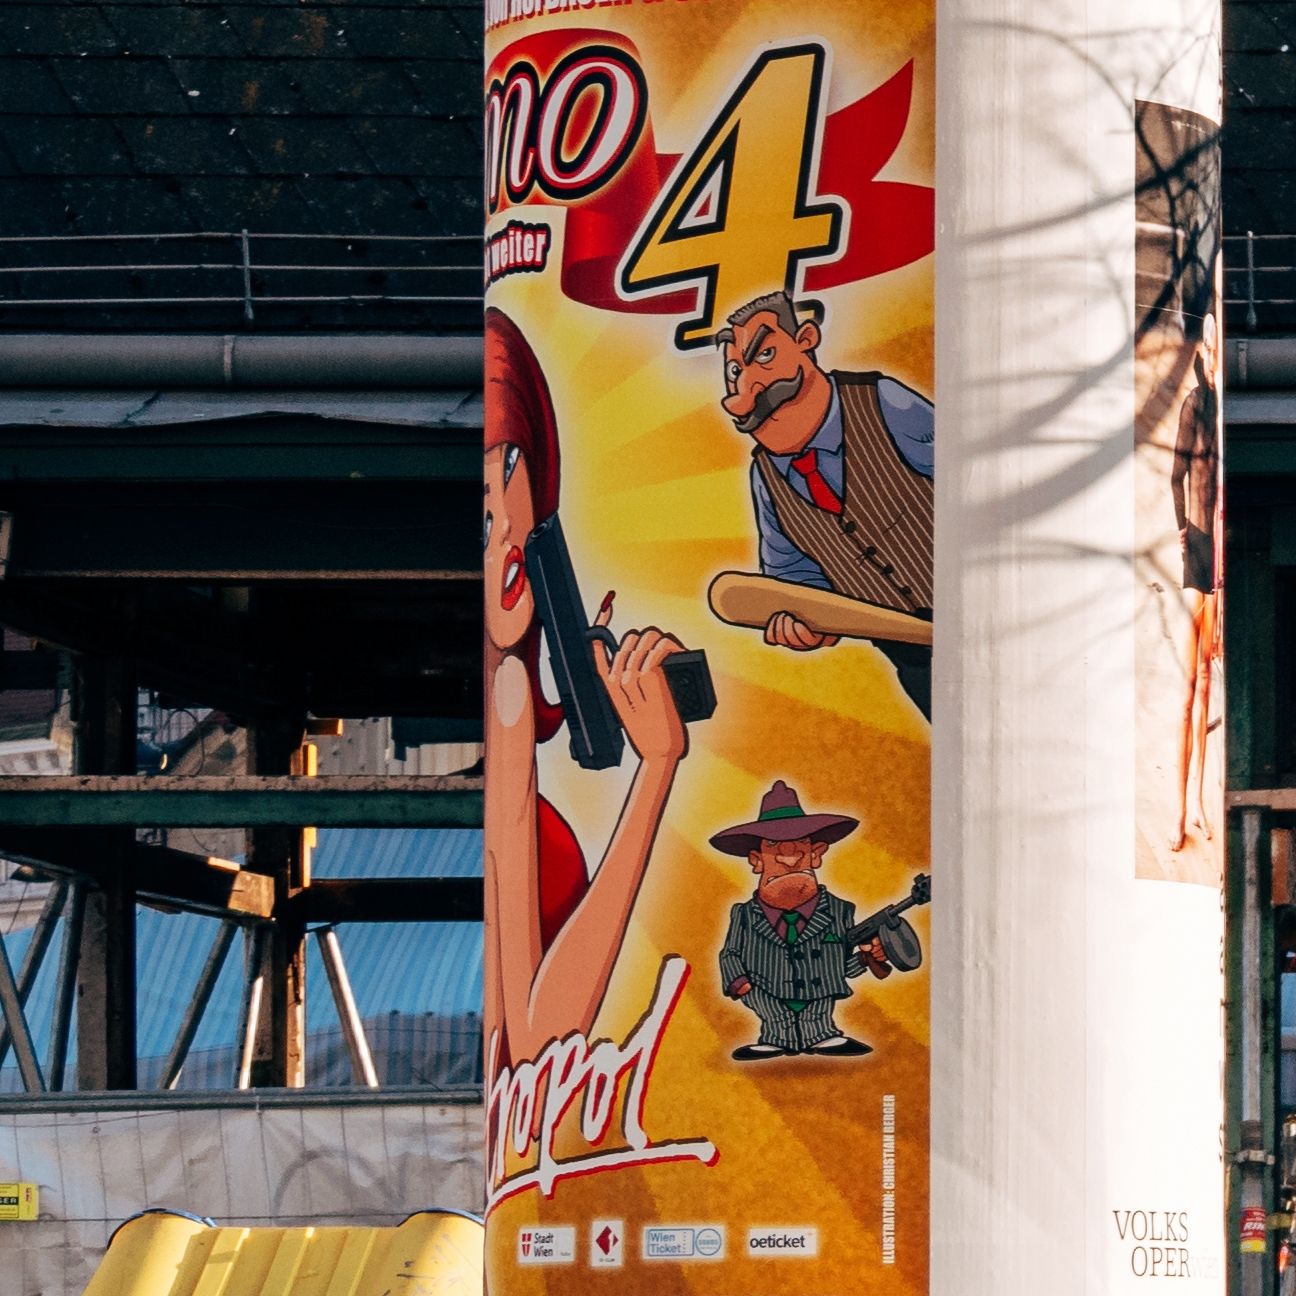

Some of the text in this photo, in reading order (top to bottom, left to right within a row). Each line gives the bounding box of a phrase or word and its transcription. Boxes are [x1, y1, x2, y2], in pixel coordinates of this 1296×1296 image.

[620, 41, 845, 351] 4
[490, 224, 549, 279] weiter
[882, 1094, 896, 1264] ILLUSTRATION: CHRISTIAN BERGER
[533, 1232, 554, 1244] Stadt
[650, 1233, 676, 1243] Wien
[1112, 1209, 1189, 1243] VOLKS
[533, 1246, 554, 1257] Wien
[650, 1243, 682, 1254] Ticket
[749, 1233, 806, 1249] oeticket
[1131, 1245, 1191, 1278] OPER
